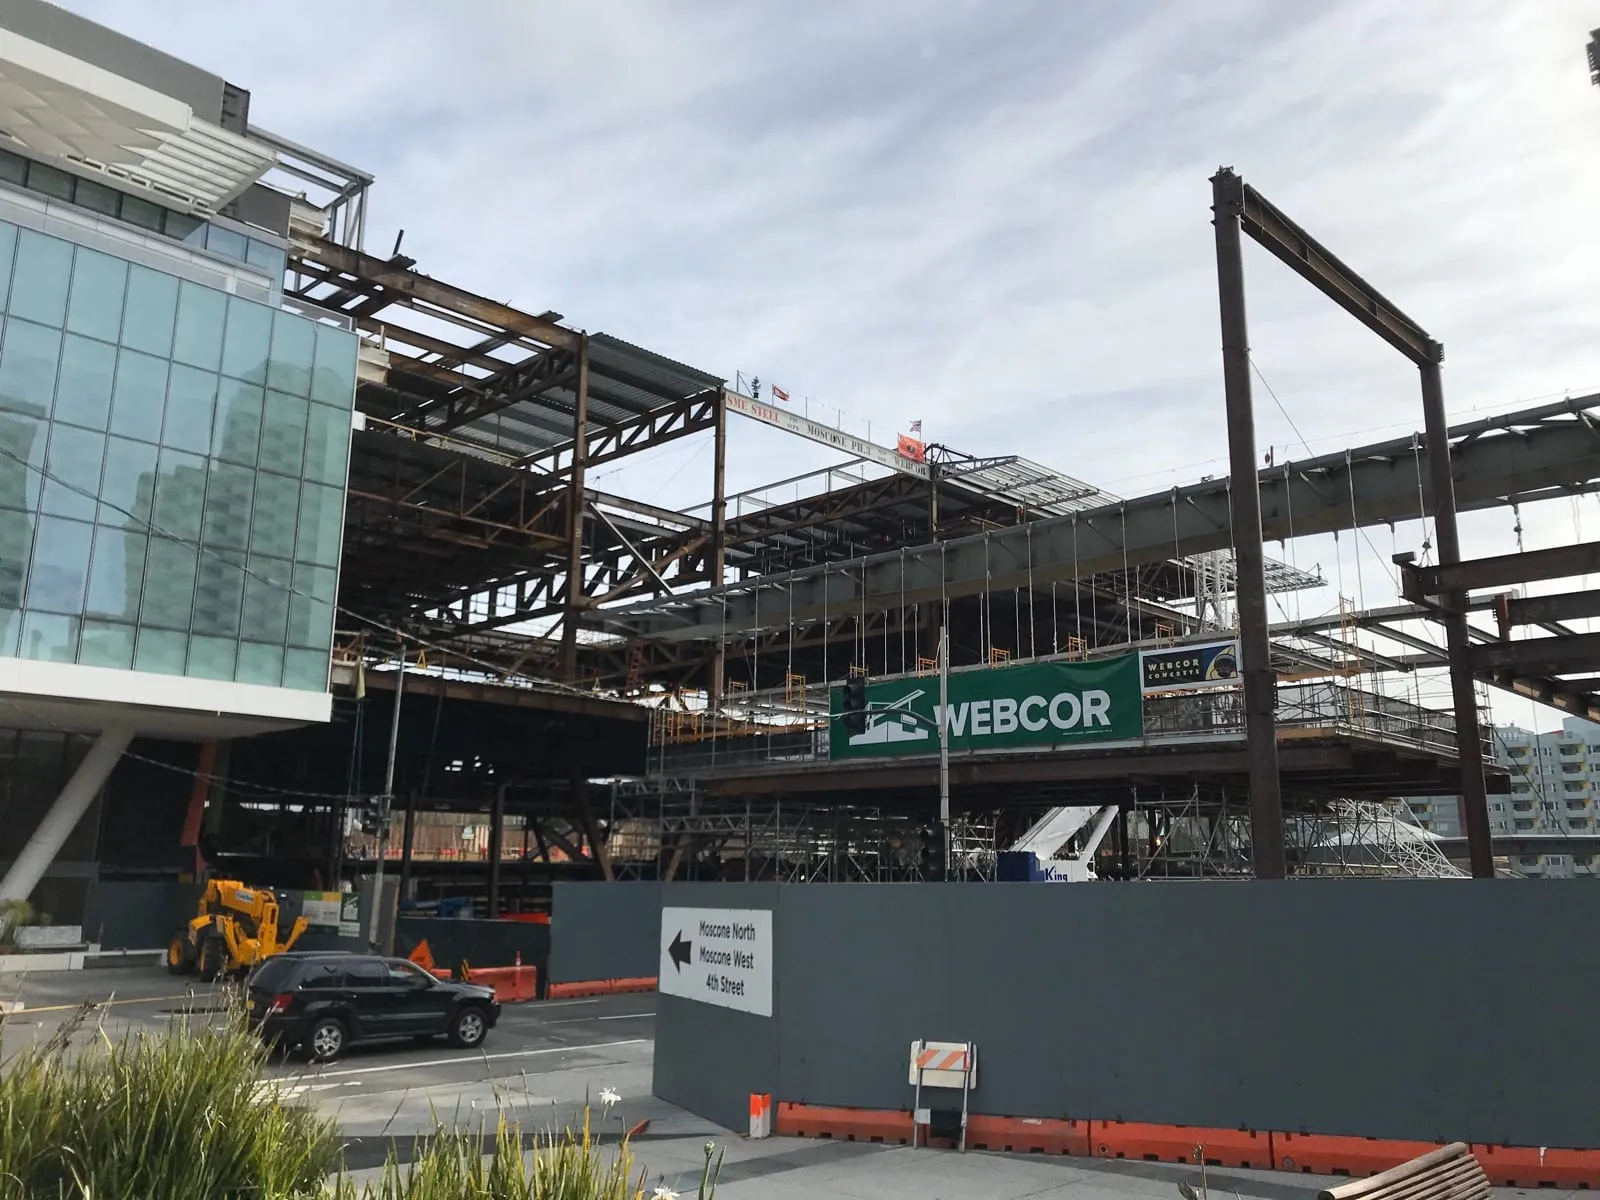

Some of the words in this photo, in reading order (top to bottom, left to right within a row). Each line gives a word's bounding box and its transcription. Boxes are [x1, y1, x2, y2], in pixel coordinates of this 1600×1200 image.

[807, 424, 847, 447] MOSCONE
[1147, 658, 1200, 672] WEBCOR
[1148, 668, 1200, 680] CONCRETE
[932, 690, 1112, 737] WEBCOR
[1045, 866, 1068, 882] King
[699, 920, 731, 939] Moscone
[732, 922, 756, 941] North
[700, 946, 731, 966] Moscone
[733, 950, 754, 969] West
[706, 973, 719, 992] 4th
[720, 975, 745, 997] Street
